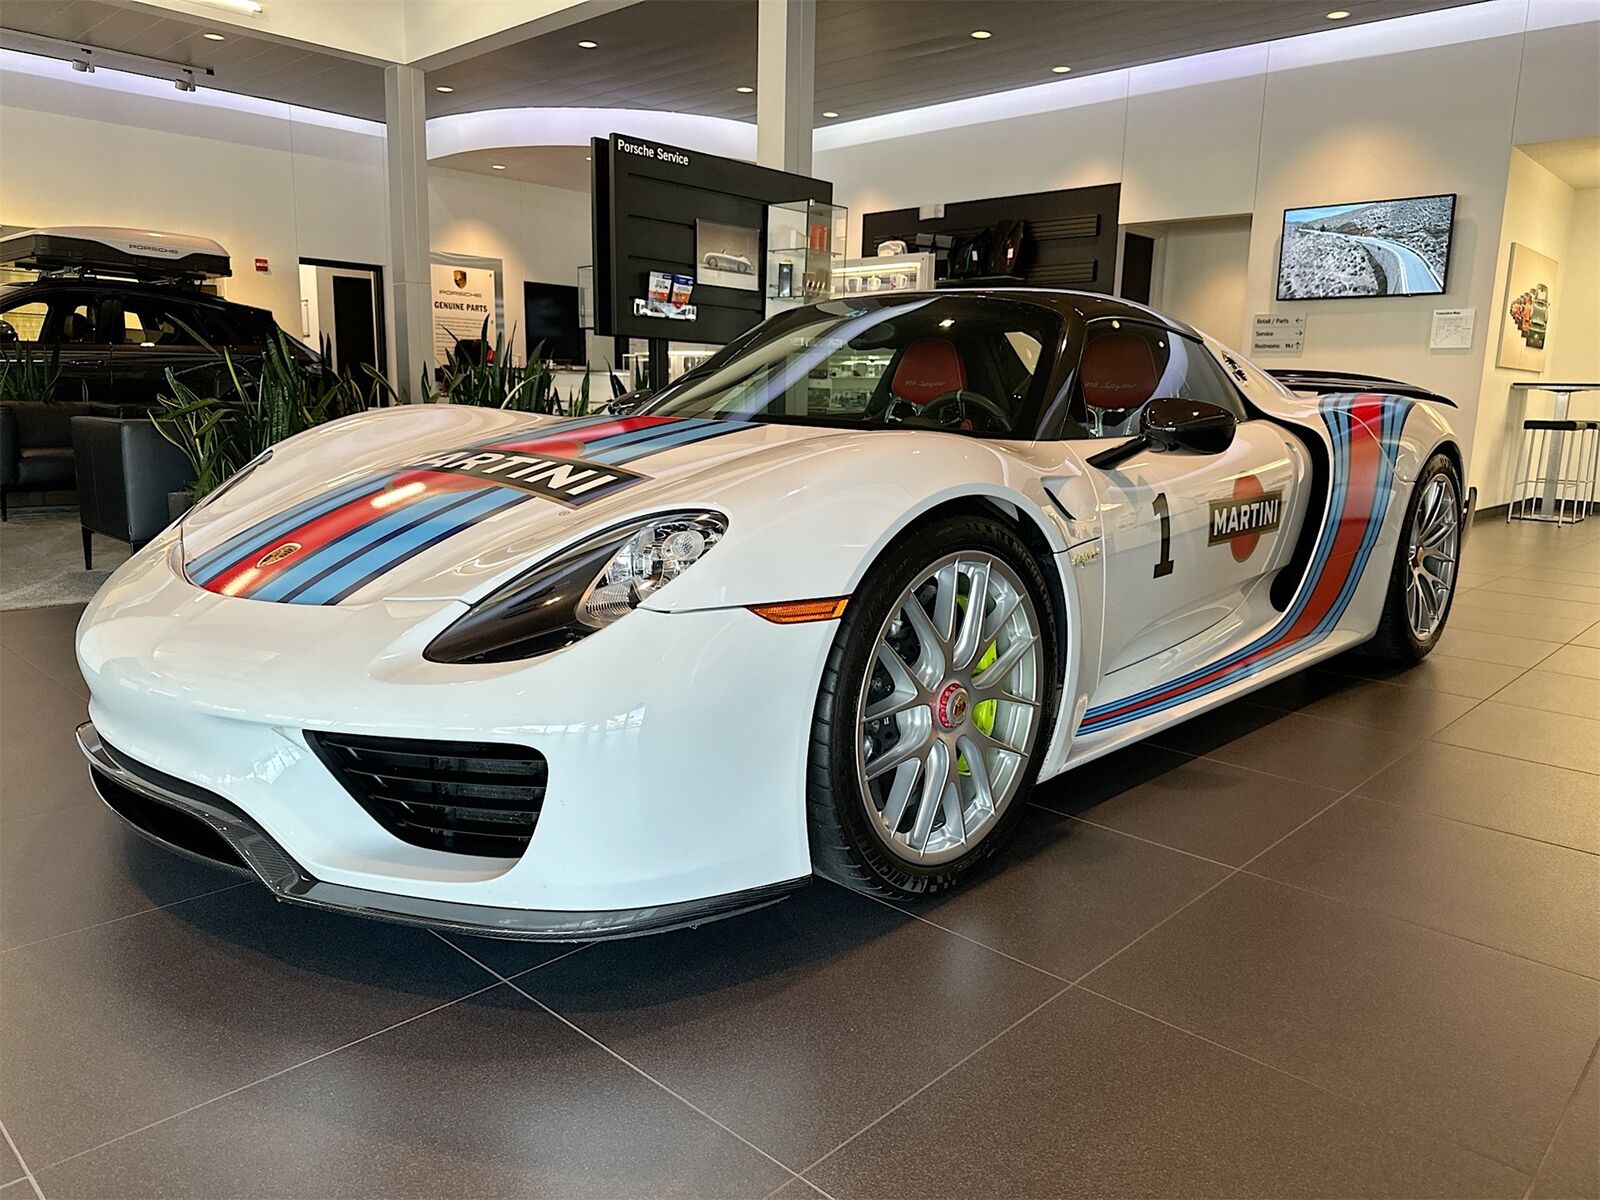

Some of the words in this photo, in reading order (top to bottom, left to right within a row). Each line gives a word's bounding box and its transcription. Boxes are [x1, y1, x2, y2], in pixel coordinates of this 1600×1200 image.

[617, 138, 655, 158] Porsche
[656, 147, 689, 166] Service
[128, 243, 179, 255] PORSCHE
[438, 289, 482, 298] PORSCHE
[434, 301, 465, 311] GENUINE
[466, 303, 488, 313] PARTS
[1213, 499, 1279, 537] MARTINI
[1151, 492, 1175, 579] 1
